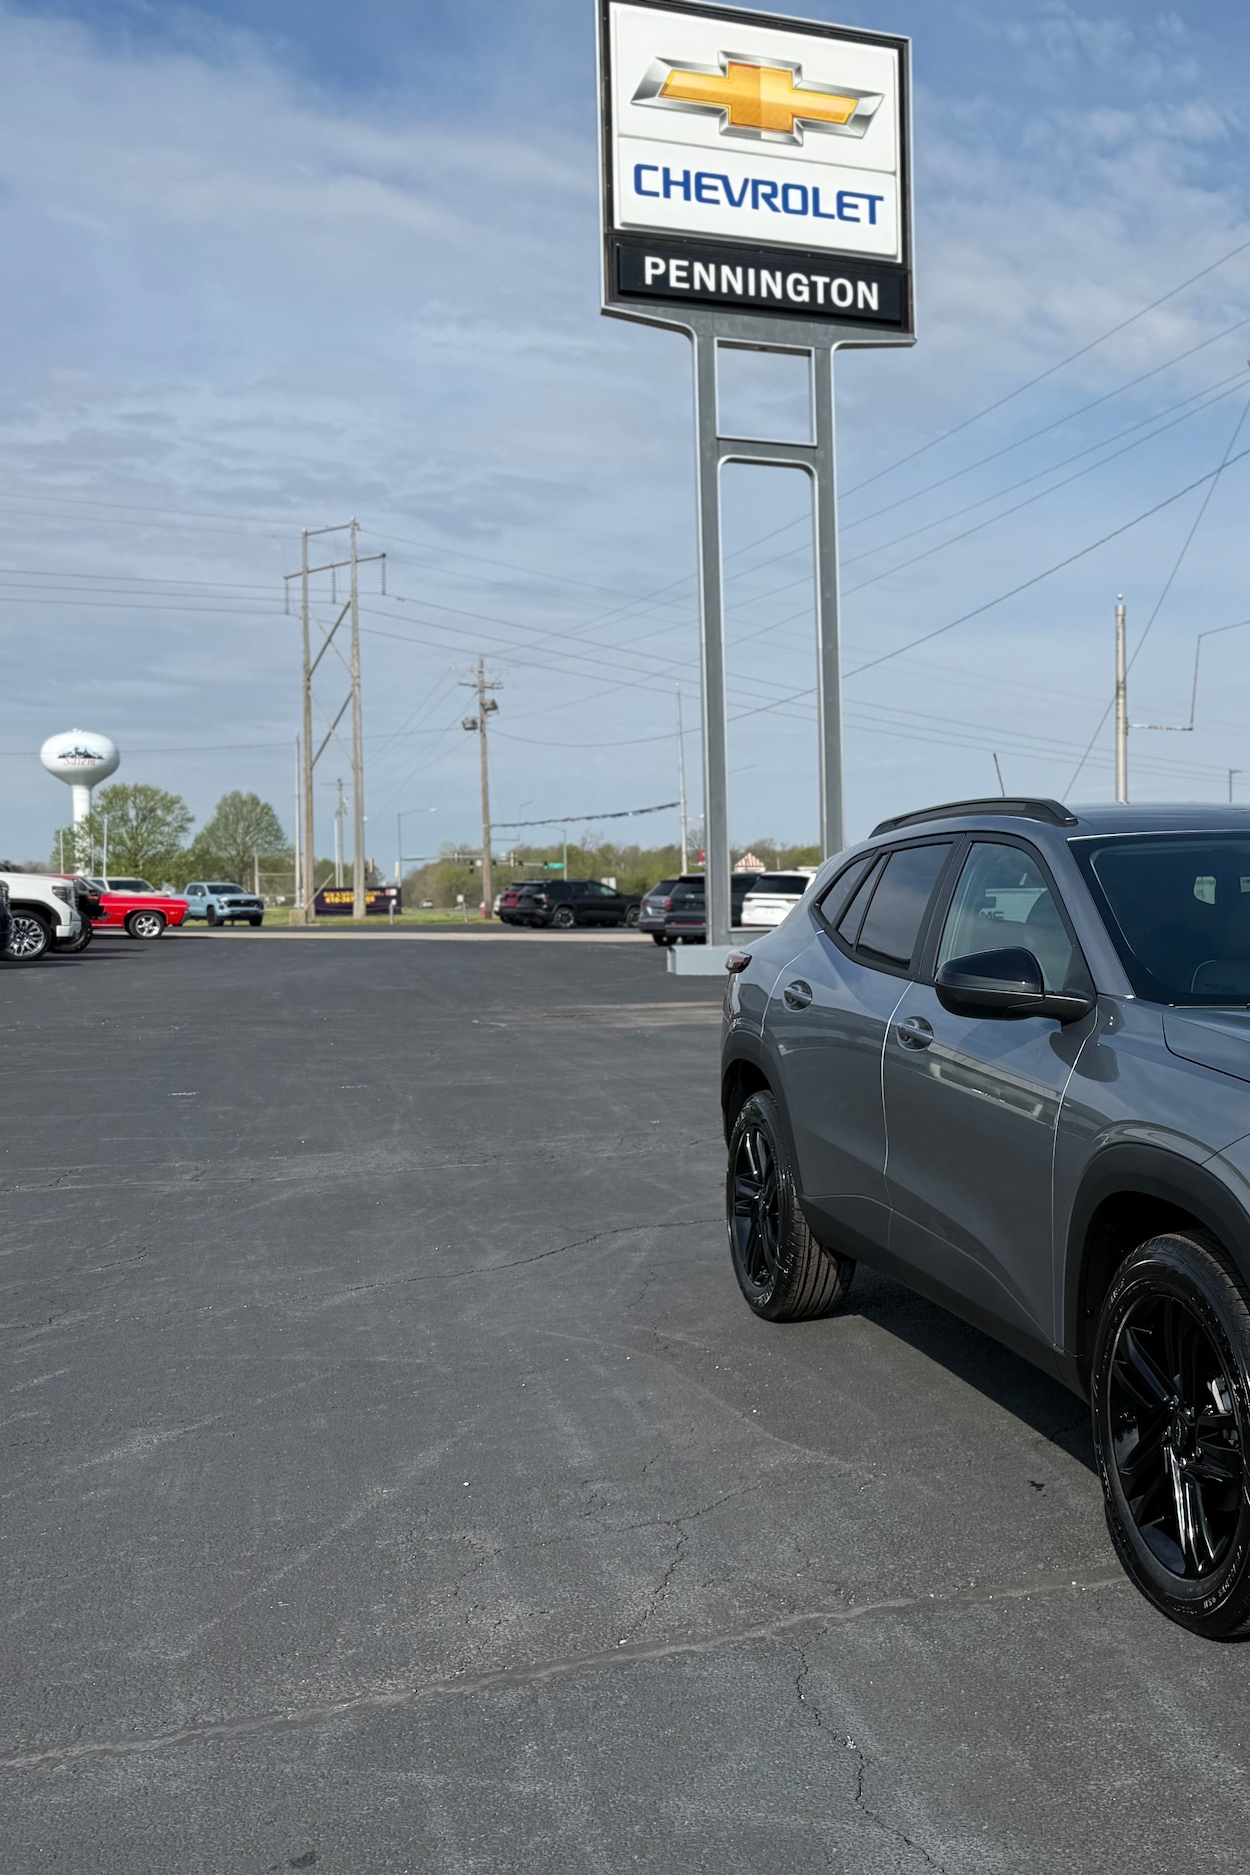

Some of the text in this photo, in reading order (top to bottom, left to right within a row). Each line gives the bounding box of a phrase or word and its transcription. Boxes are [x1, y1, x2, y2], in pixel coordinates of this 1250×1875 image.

[633, 163, 884, 225] CHEVROLET
[644, 255, 880, 311] PENNINGTON
[64, 757, 96, 766] Salem
